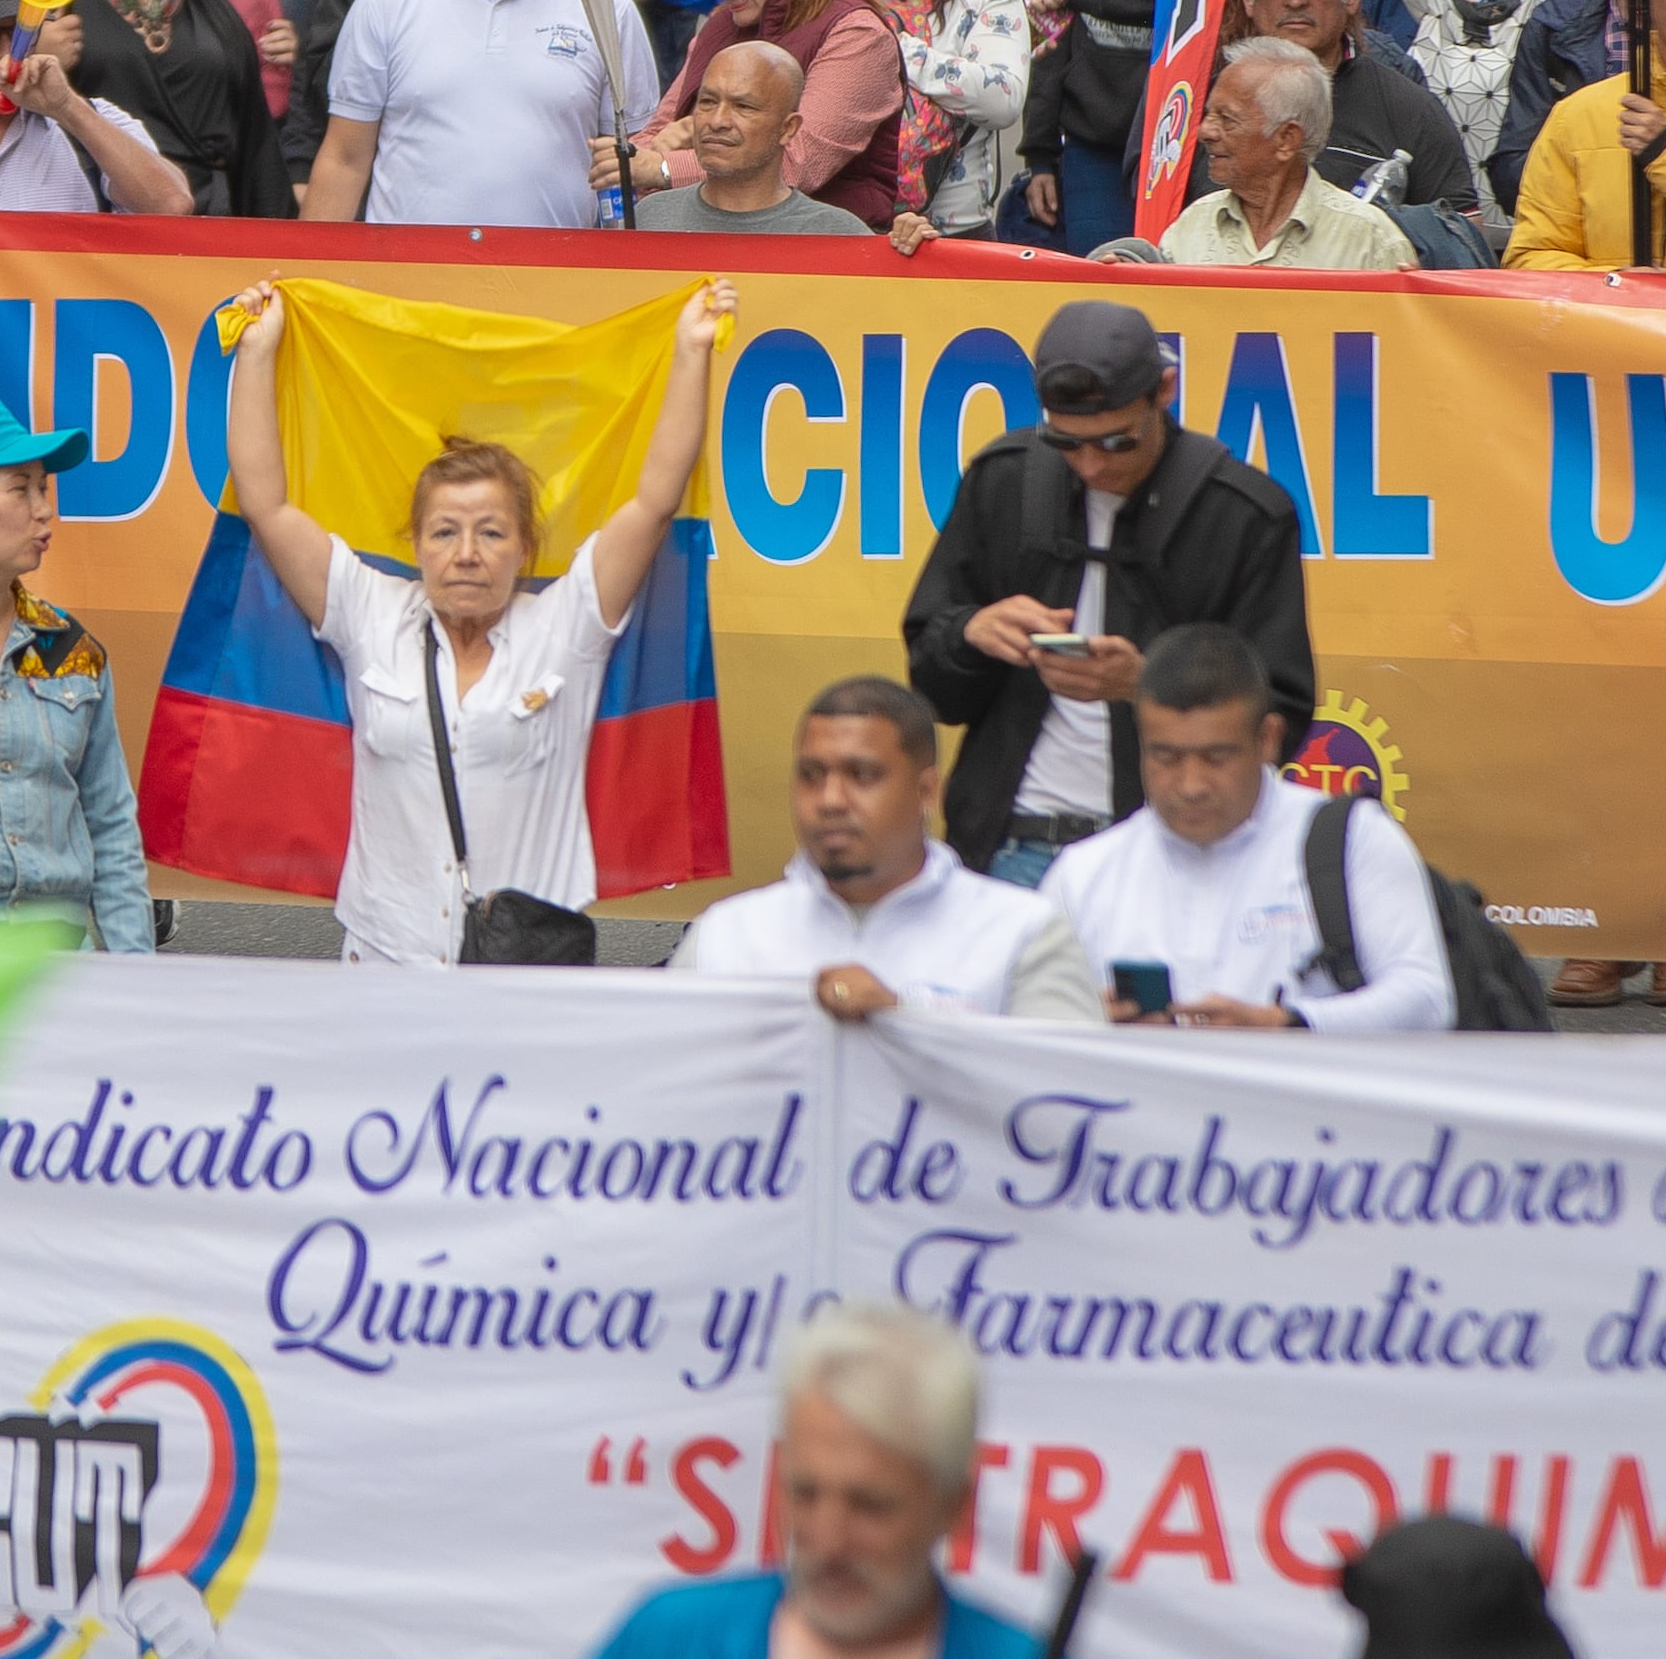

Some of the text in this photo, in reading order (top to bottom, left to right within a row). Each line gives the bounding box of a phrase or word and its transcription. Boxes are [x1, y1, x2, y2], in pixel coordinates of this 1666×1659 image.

[346, 1076, 804, 1201] Nacional
[849, 1099, 960, 1203] de
[993, 1093, 1621, 1249] Trabajadores
[268, 1219, 665, 1375] Química
[895, 1226, 1547, 1369] Farmaceutica
